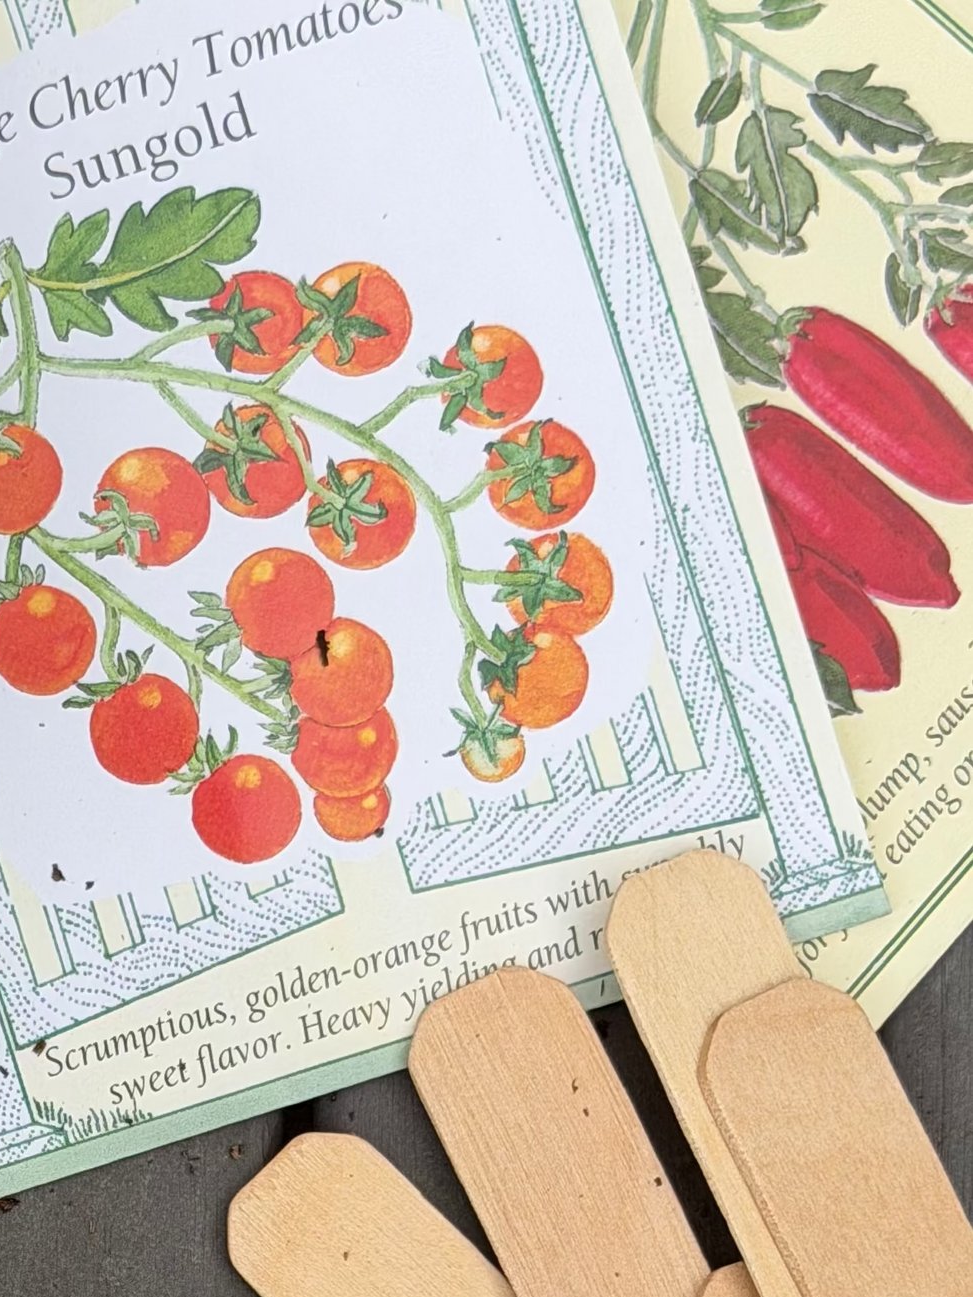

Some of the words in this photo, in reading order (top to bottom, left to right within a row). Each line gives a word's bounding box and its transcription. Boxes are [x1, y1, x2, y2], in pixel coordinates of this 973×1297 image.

[29, 57, 179, 131] Cherry
[192, 0, 403, 77] Tomatoes
[43, 91, 257, 199] Sungold
[885, 783, 963, 865] eating
[45, 1000, 237, 1077] Scrumptious,
[244, 928, 453, 1022] golden-orange
[459, 901, 538, 956] fruits
[545, 870, 614, 916] with
[108, 1060, 191, 1106] sweet
[194, 1029, 291, 1087] flavor.
[298, 995, 392, 1045] Heavy
[527, 925, 583, 970] and
